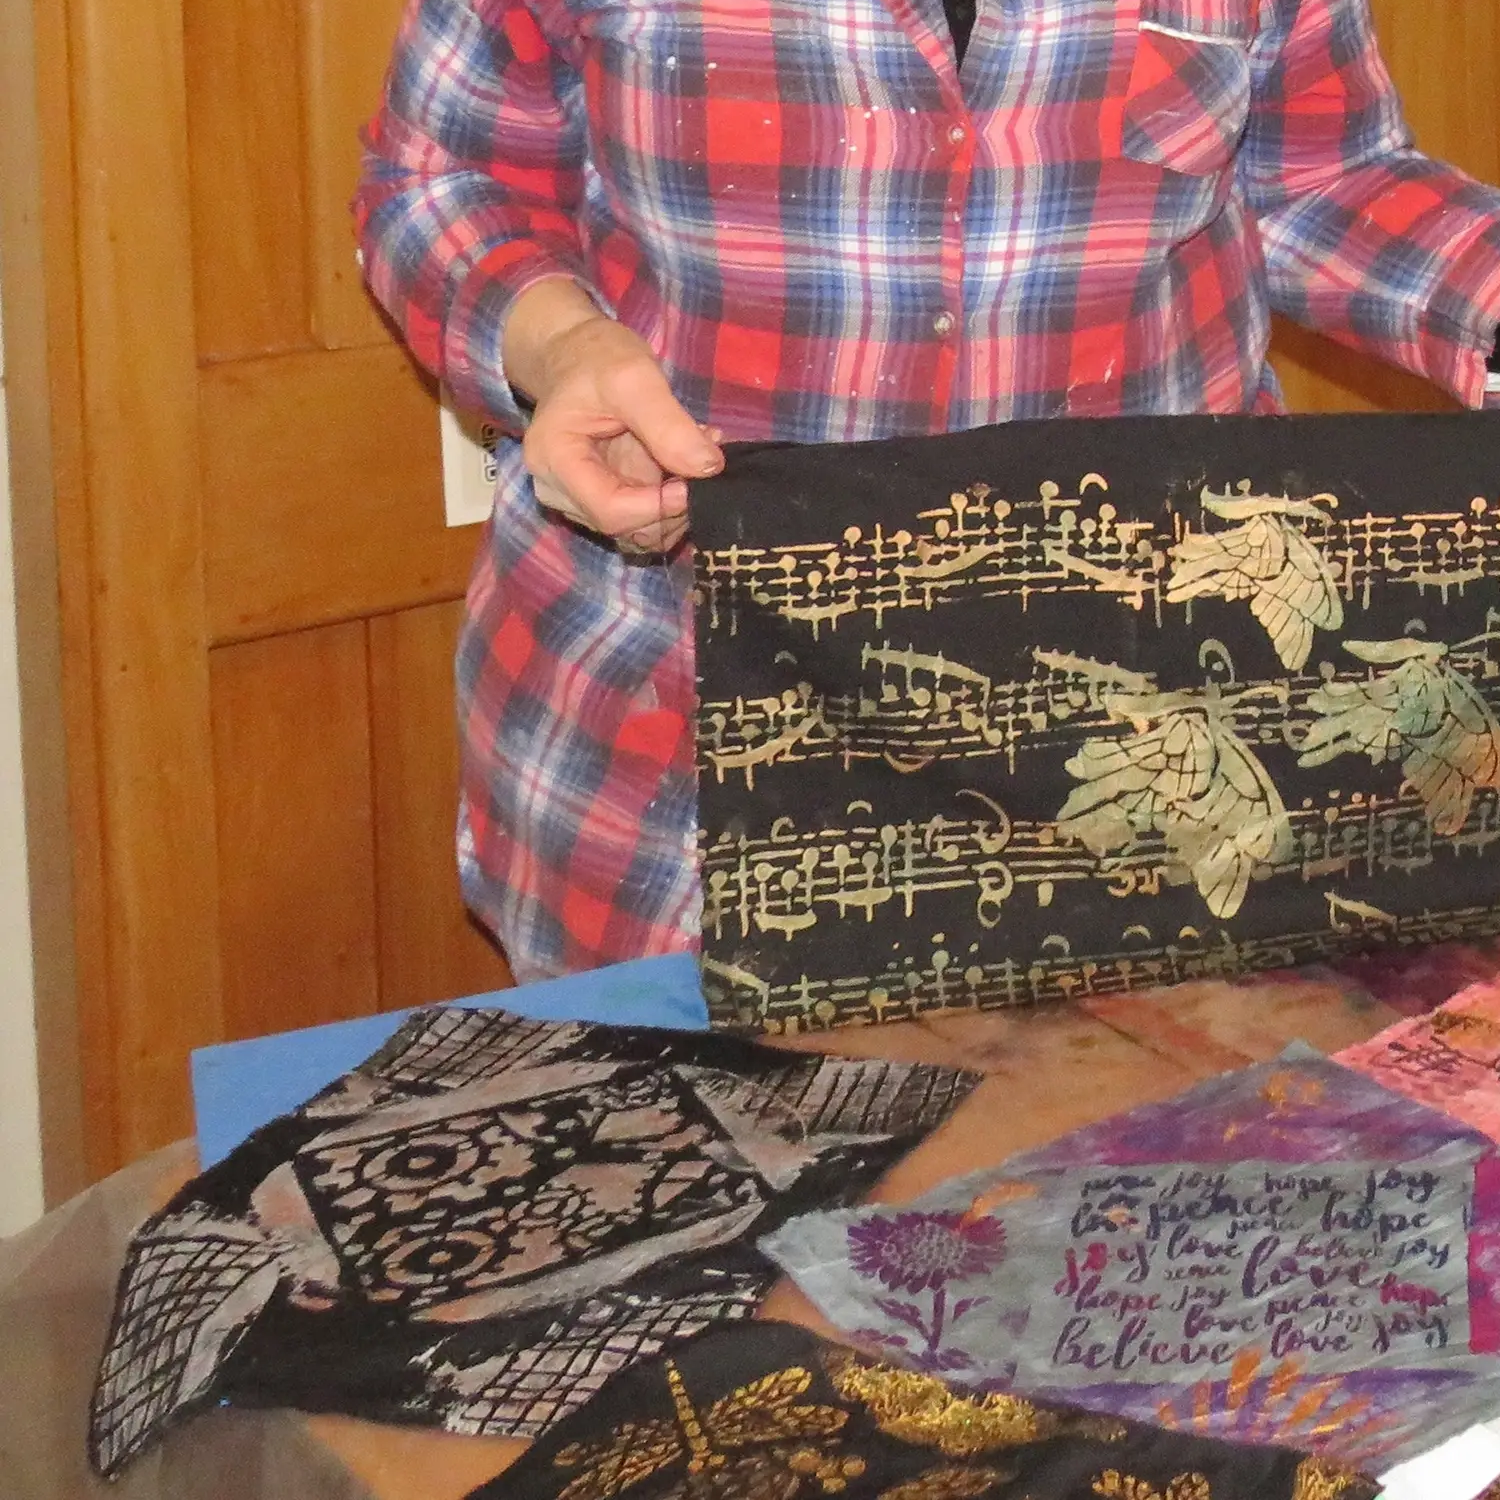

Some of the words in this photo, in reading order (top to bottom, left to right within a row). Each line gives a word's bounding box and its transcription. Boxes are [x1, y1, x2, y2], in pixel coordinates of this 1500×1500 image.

[1365, 1167, 1441, 1204] joy
[1320, 1191, 1433, 1243] hope
[1167, 1222, 1243, 1260] love
[1388, 1238, 1450, 1279] joy
[1241, 1234, 1382, 1300] love
[1074, 1274, 1163, 1322] hope
[1184, 1303, 1259, 1339] love
[1270, 1317, 1353, 1358] love
[1371, 1311, 1448, 1354] joy
